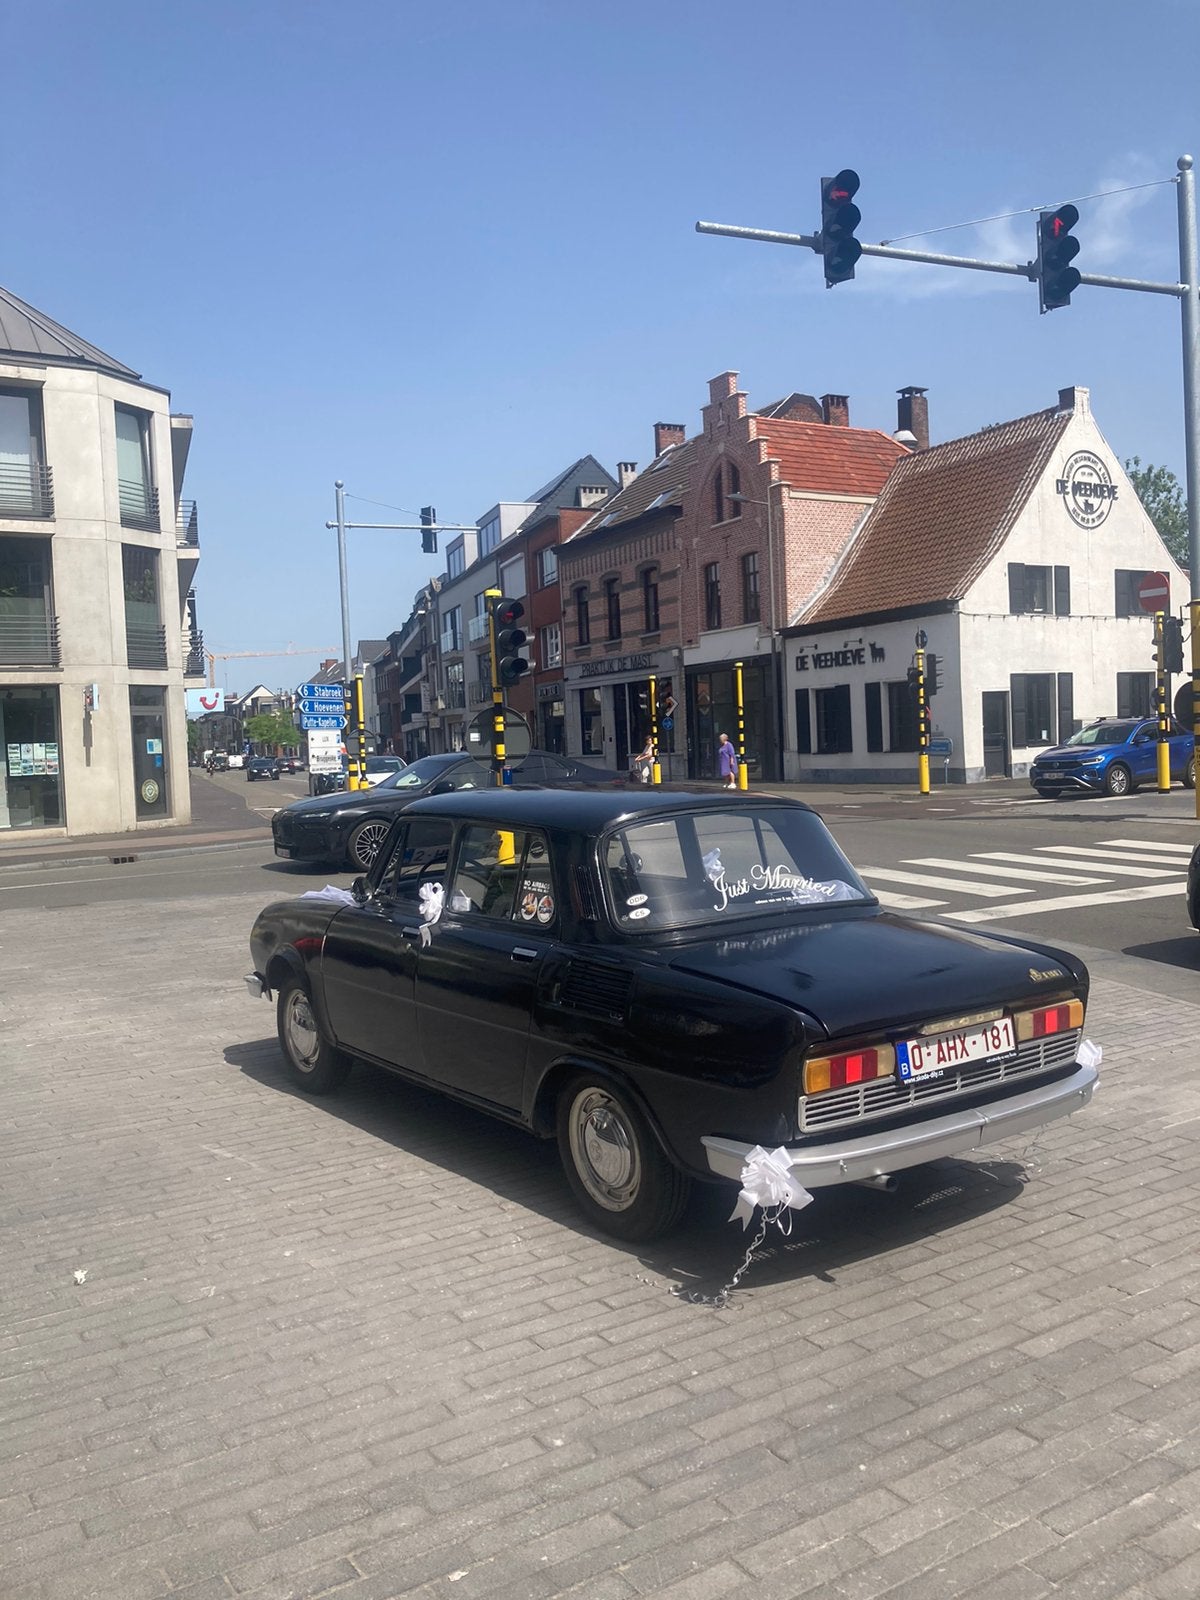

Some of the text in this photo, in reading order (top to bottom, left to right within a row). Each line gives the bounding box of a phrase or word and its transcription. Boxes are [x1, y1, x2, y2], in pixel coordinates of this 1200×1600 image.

[1056, 479, 1119, 501] DE VEEHOEVE
[581, 654, 651, 676] PRAKTIJK DE MAST
[795, 648, 866, 672] DE VEEHOEVE
[303, 688, 342, 697] 6 Stabroek
[304, 701, 344, 712] 2 Hoevenen
[303, 717, 343, 728] Putte-Kapellen 5
[713, 864, 836, 912] Just Married
[629, 895, 645, 905] DDR
[900, 1062, 909, 1075] B
